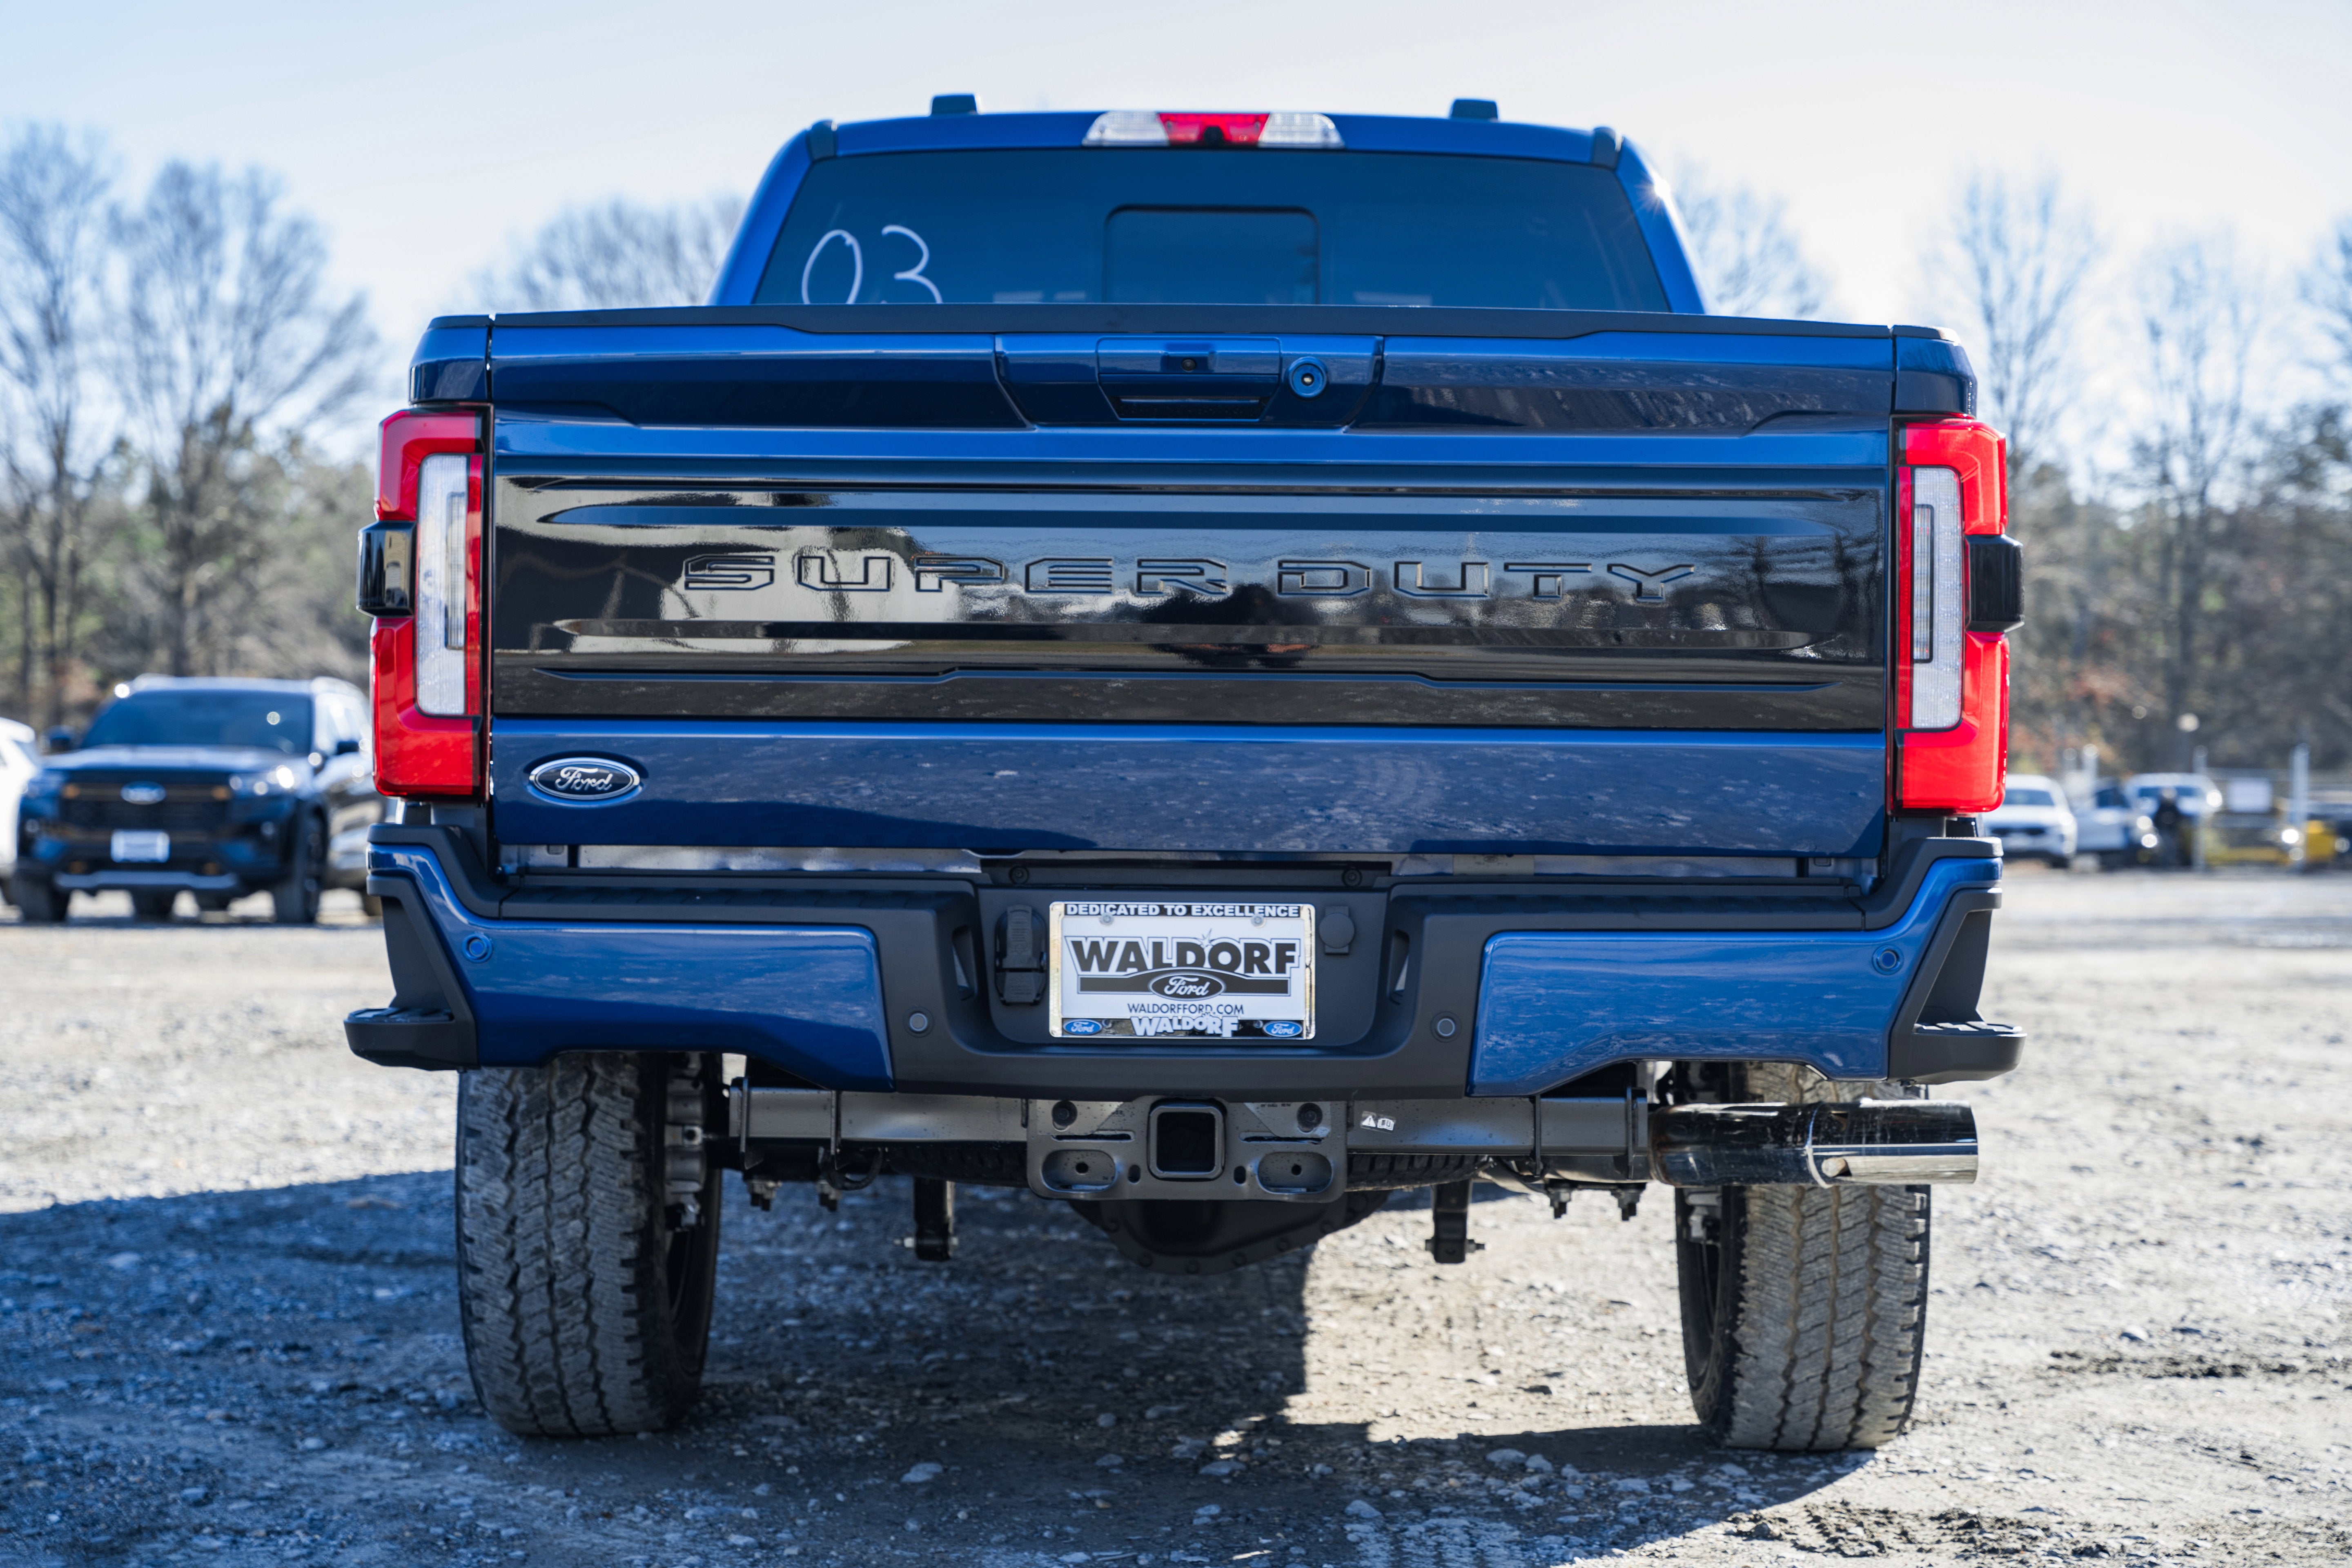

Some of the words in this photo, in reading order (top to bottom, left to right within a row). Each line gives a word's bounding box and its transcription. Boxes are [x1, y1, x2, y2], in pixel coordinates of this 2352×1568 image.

[684, 555, 1226, 595] SUPER
[1278, 559, 1695, 601] DUTY
[555, 766, 613, 791] Ford
[1067, 904, 1160, 915] DEDICATED
[1164, 905, 1187, 916] TO
[1191, 905, 1299, 917] EXCELLENCE
[1071, 940, 1296, 974] WALDORF
[1164, 976, 1209, 996] Ford
[1127, 1003, 1244, 1014] WALDORFFORD.COM
[1071, 1021, 1095, 1032] Ford
[1131, 1017, 1238, 1038] WALDORF
[1271, 1023, 1295, 1034] Ford
